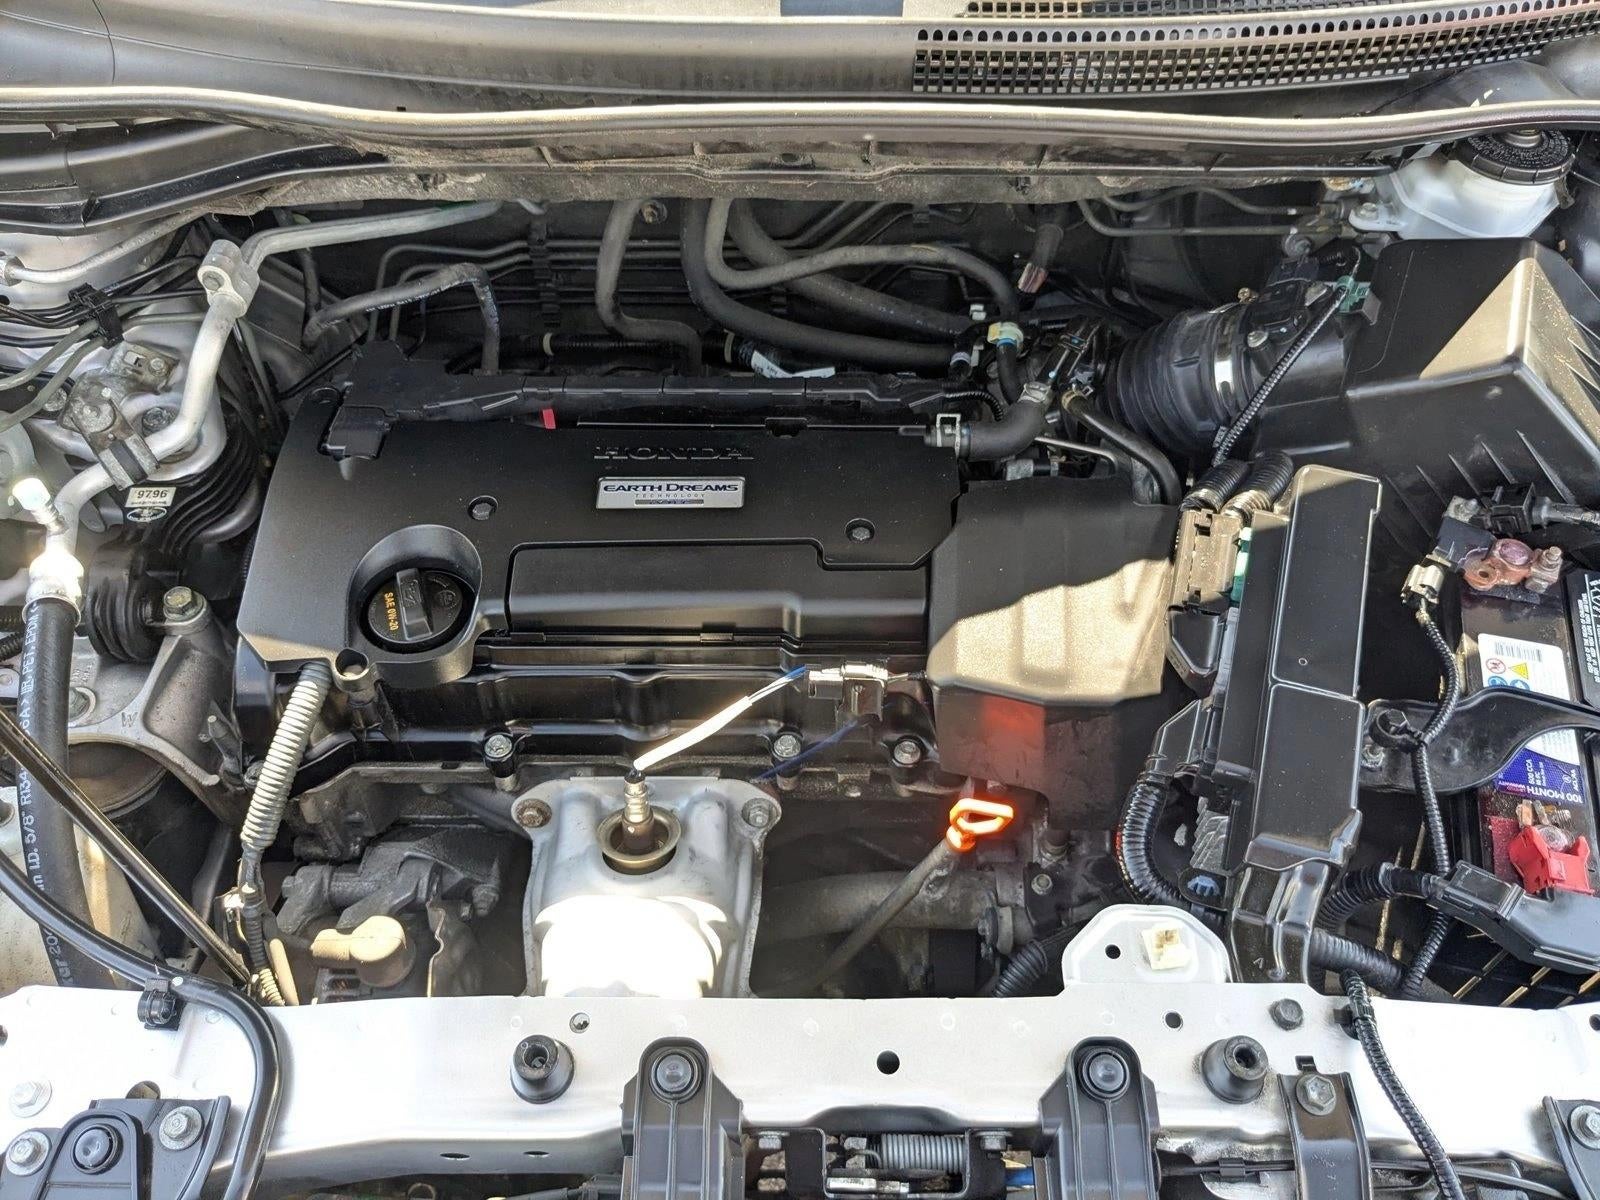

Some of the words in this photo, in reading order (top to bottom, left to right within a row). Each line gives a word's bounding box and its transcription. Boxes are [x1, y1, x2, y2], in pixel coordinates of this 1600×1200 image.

[594, 446, 754, 460] HONDA
[137, 489, 169, 499] 9796
[603, 484, 662, 492] EARTH
[666, 483, 739, 492] DREAMS
[384, 592, 396, 608] SAE
[387, 608, 399, 631] 0W-20
[1526, 785, 1565, 800] MONTH
[1566, 792, 1584, 804] 100
